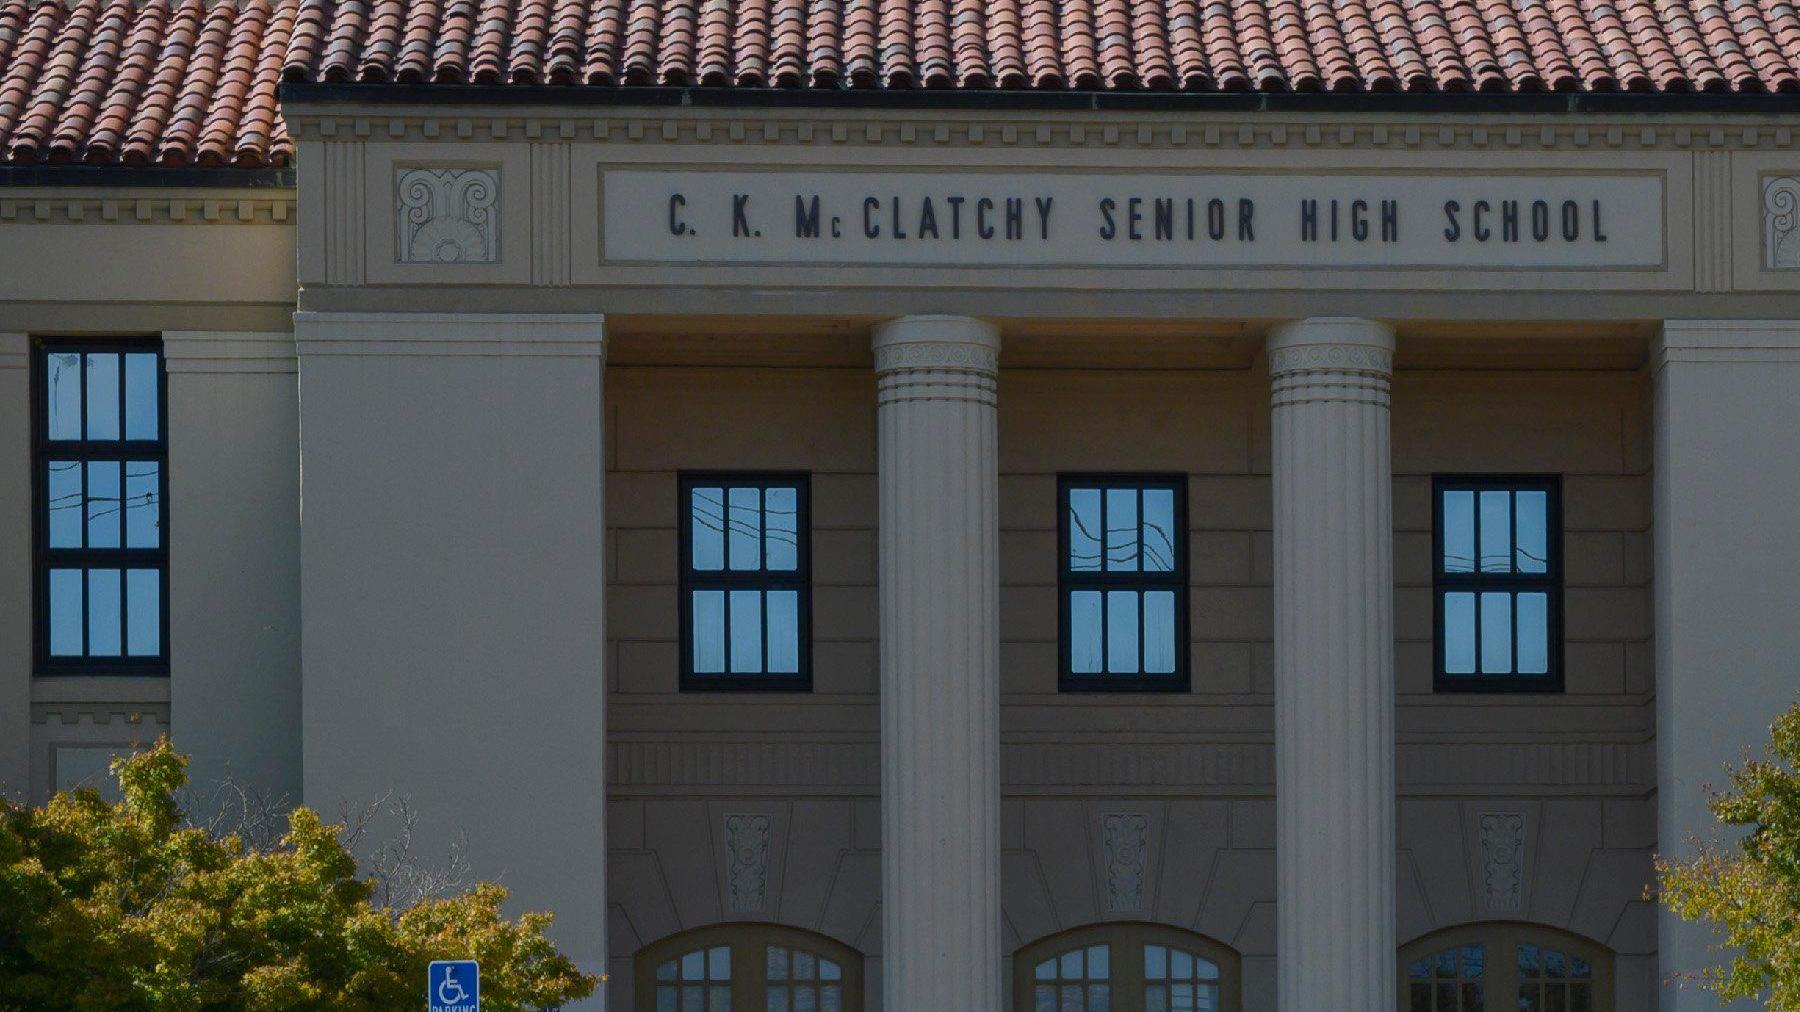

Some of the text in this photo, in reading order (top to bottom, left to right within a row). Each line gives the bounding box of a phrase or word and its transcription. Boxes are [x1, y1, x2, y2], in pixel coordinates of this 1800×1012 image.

[668, 192, 697, 238] C.
[732, 193, 761, 239] K.
[1099, 196, 1255, 241] SENIOR
[1301, 198, 1398, 241] HIGH
[1443, 198, 1608, 242] SCHOOL
